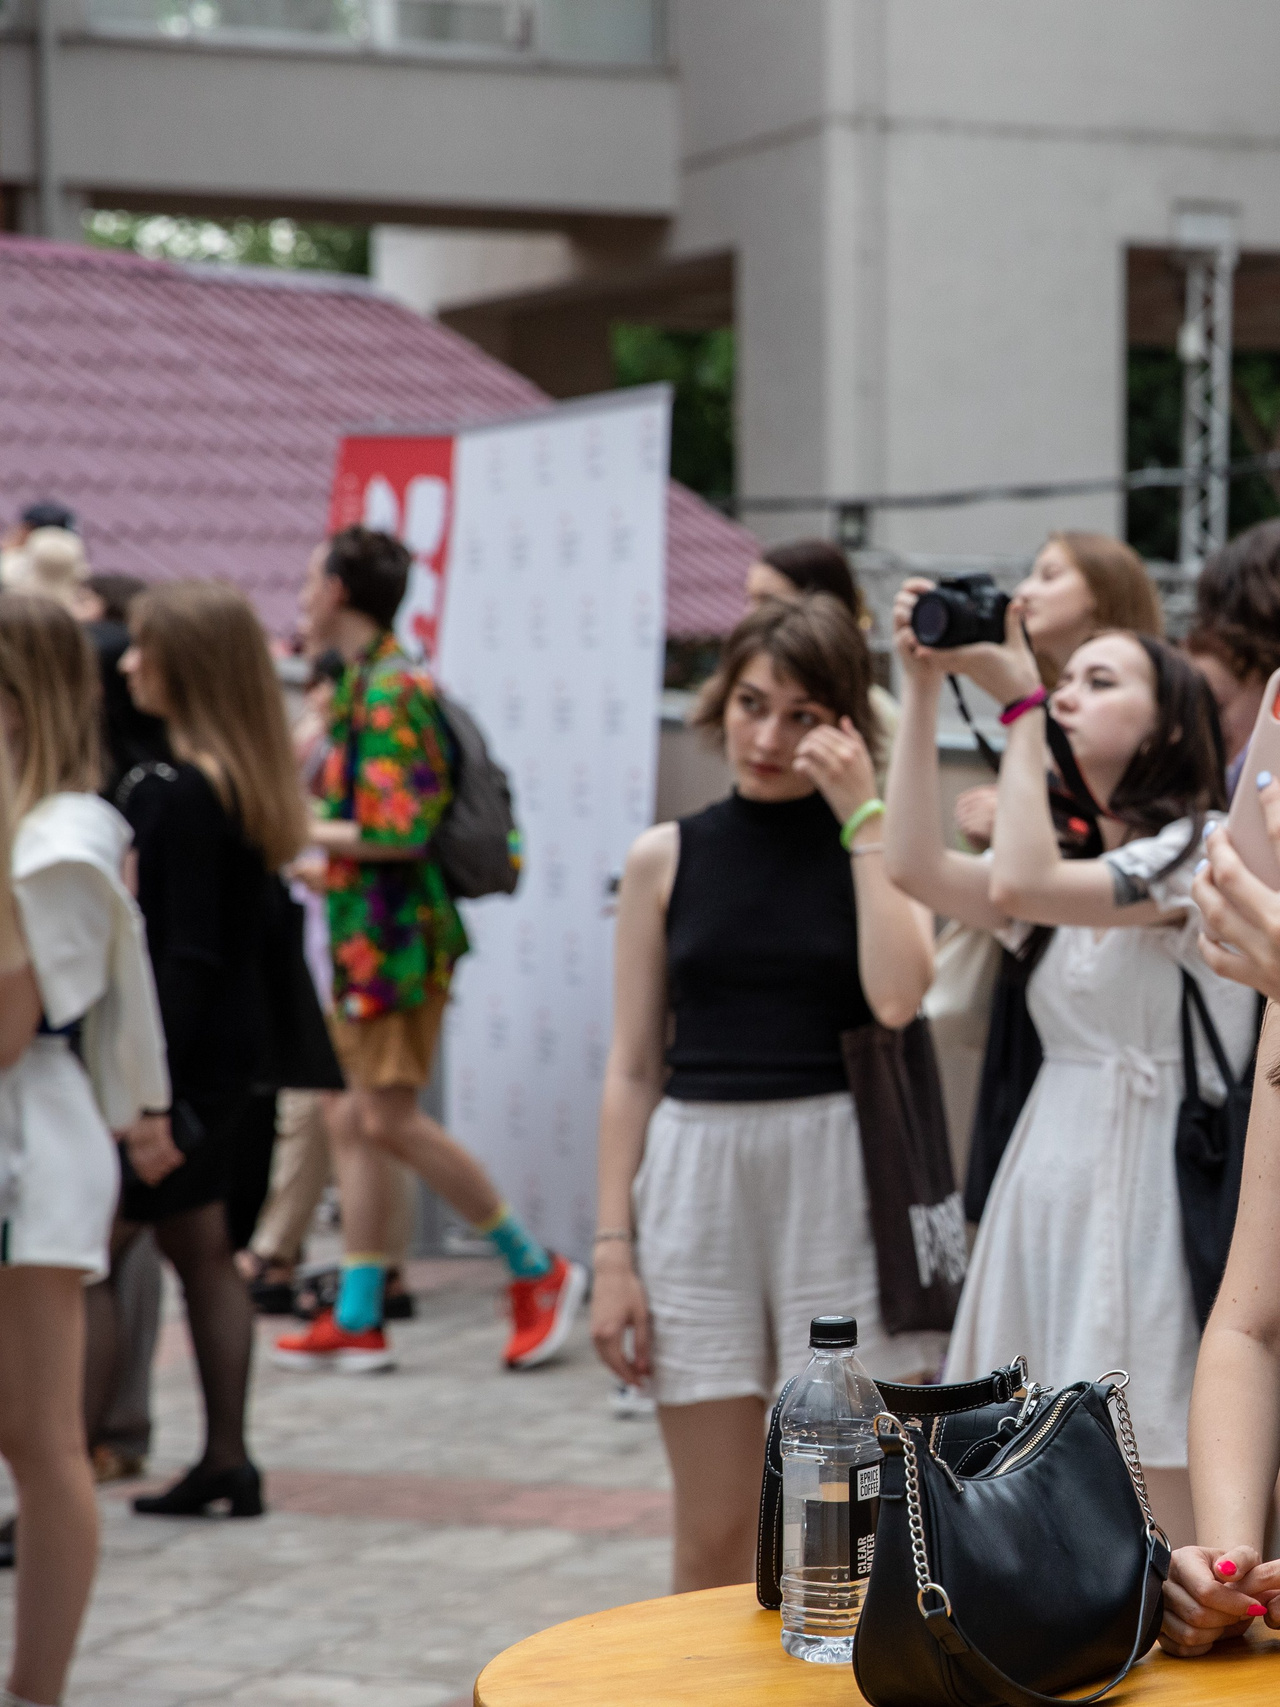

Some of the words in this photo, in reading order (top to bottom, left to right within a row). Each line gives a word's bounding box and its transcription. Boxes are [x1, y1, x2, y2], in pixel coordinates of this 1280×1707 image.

[860, 1481, 878, 1497] COFFEE
[864, 1469, 878, 1484] PRICE
[857, 1536, 867, 1575] CLEAR
[866, 1533, 875, 1573] WATER
